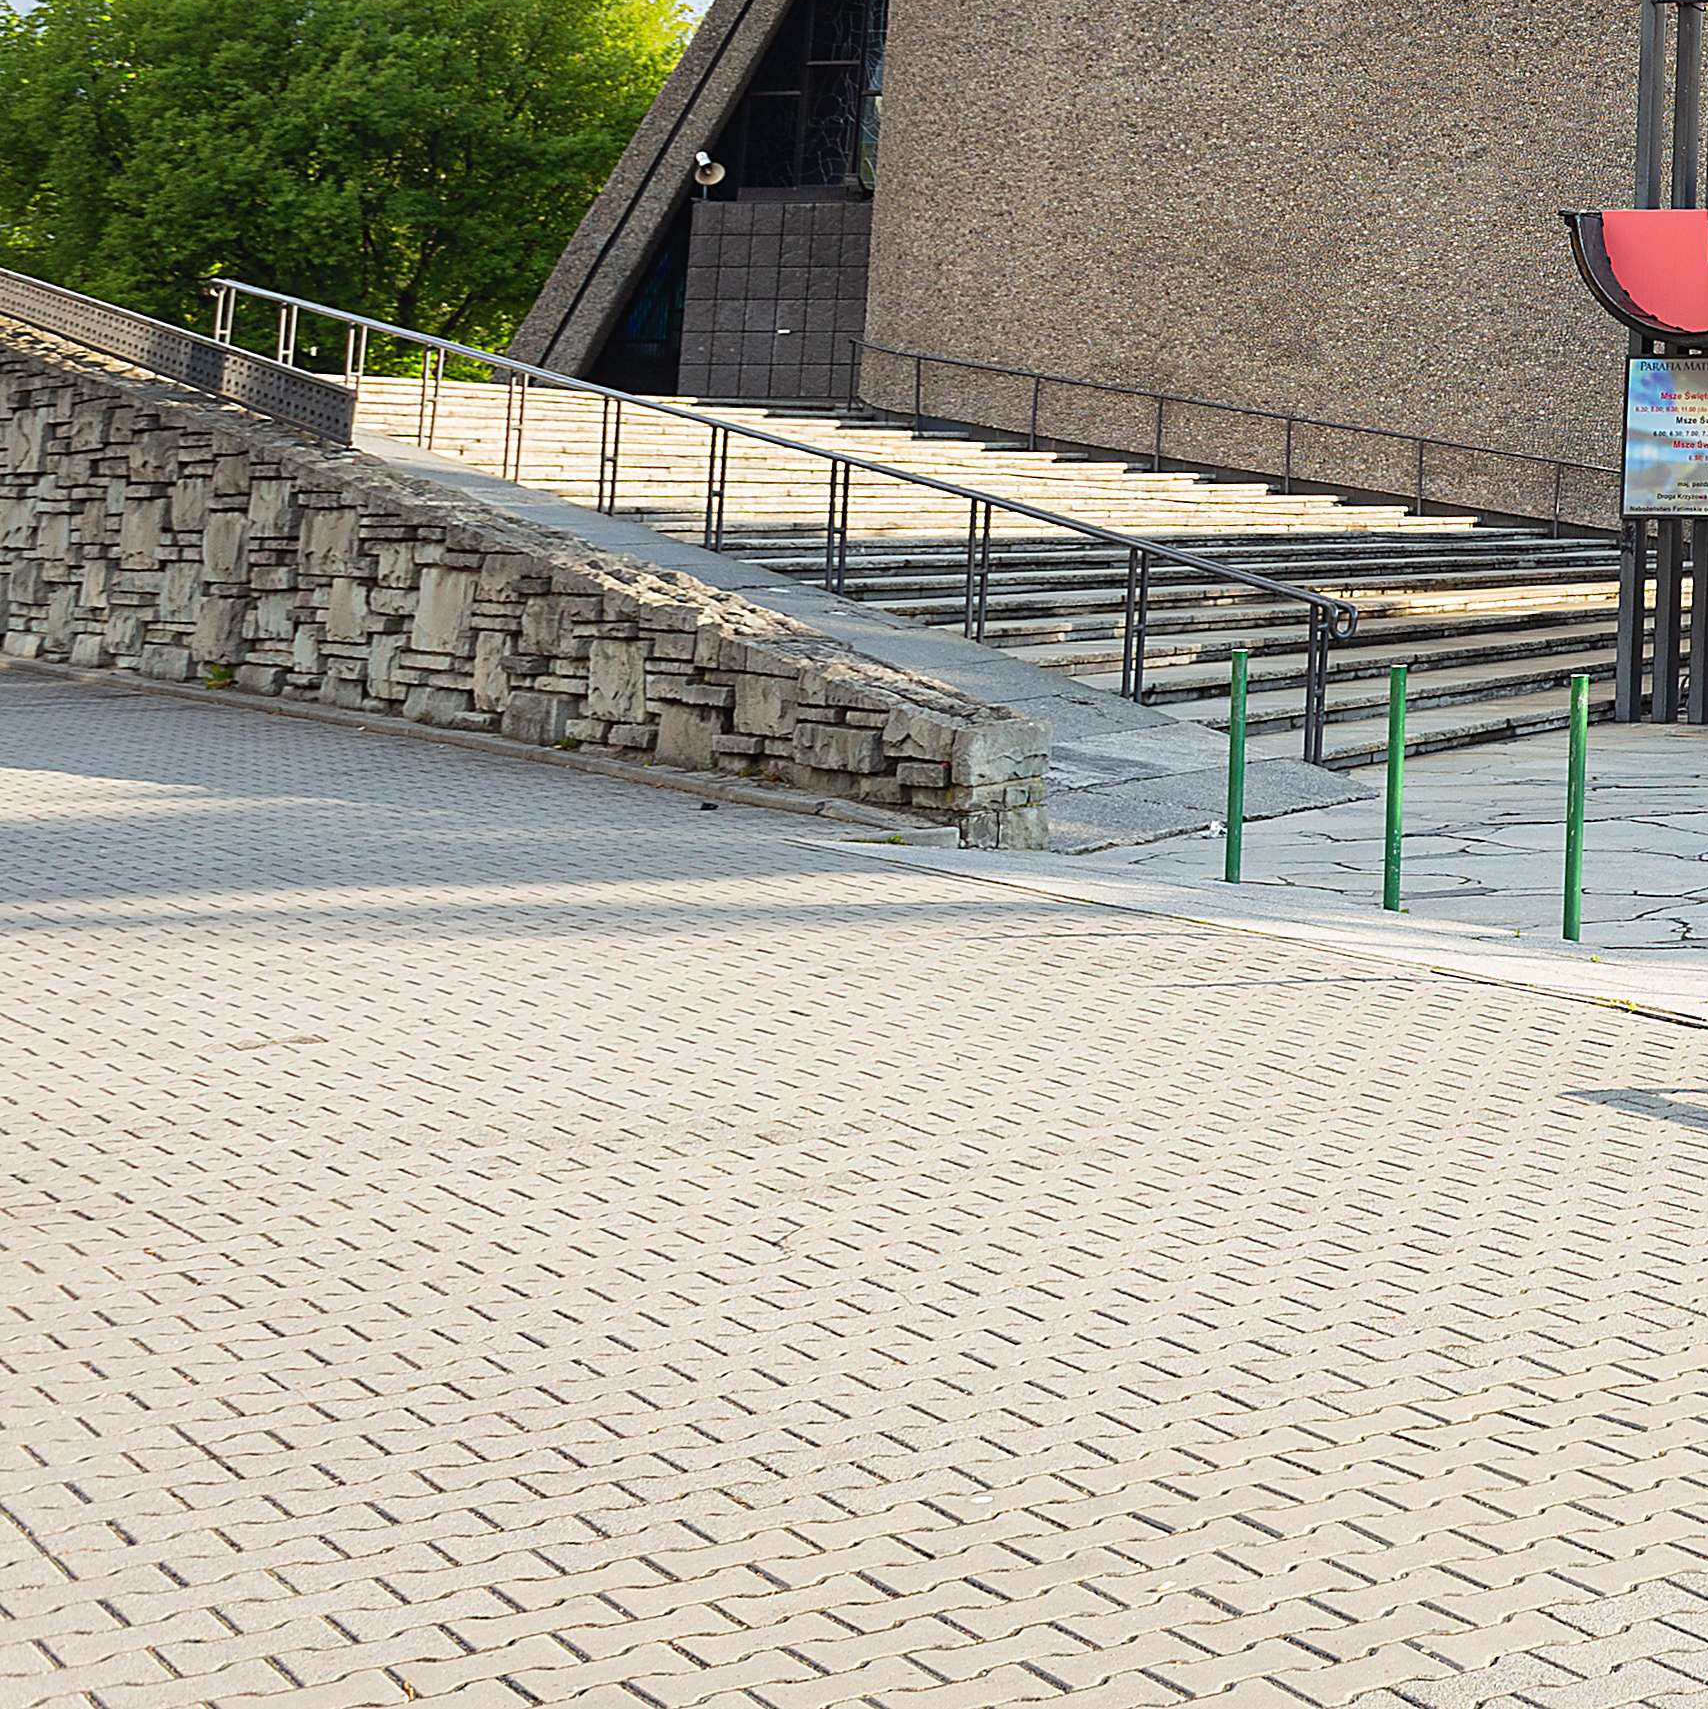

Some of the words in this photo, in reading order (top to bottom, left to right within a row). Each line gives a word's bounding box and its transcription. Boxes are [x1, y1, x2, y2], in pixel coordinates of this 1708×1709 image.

[1660, 392, 1682, 401] Msze
[1676, 416, 1697, 424] Msze
[1672, 441, 1695, 449] Msze
